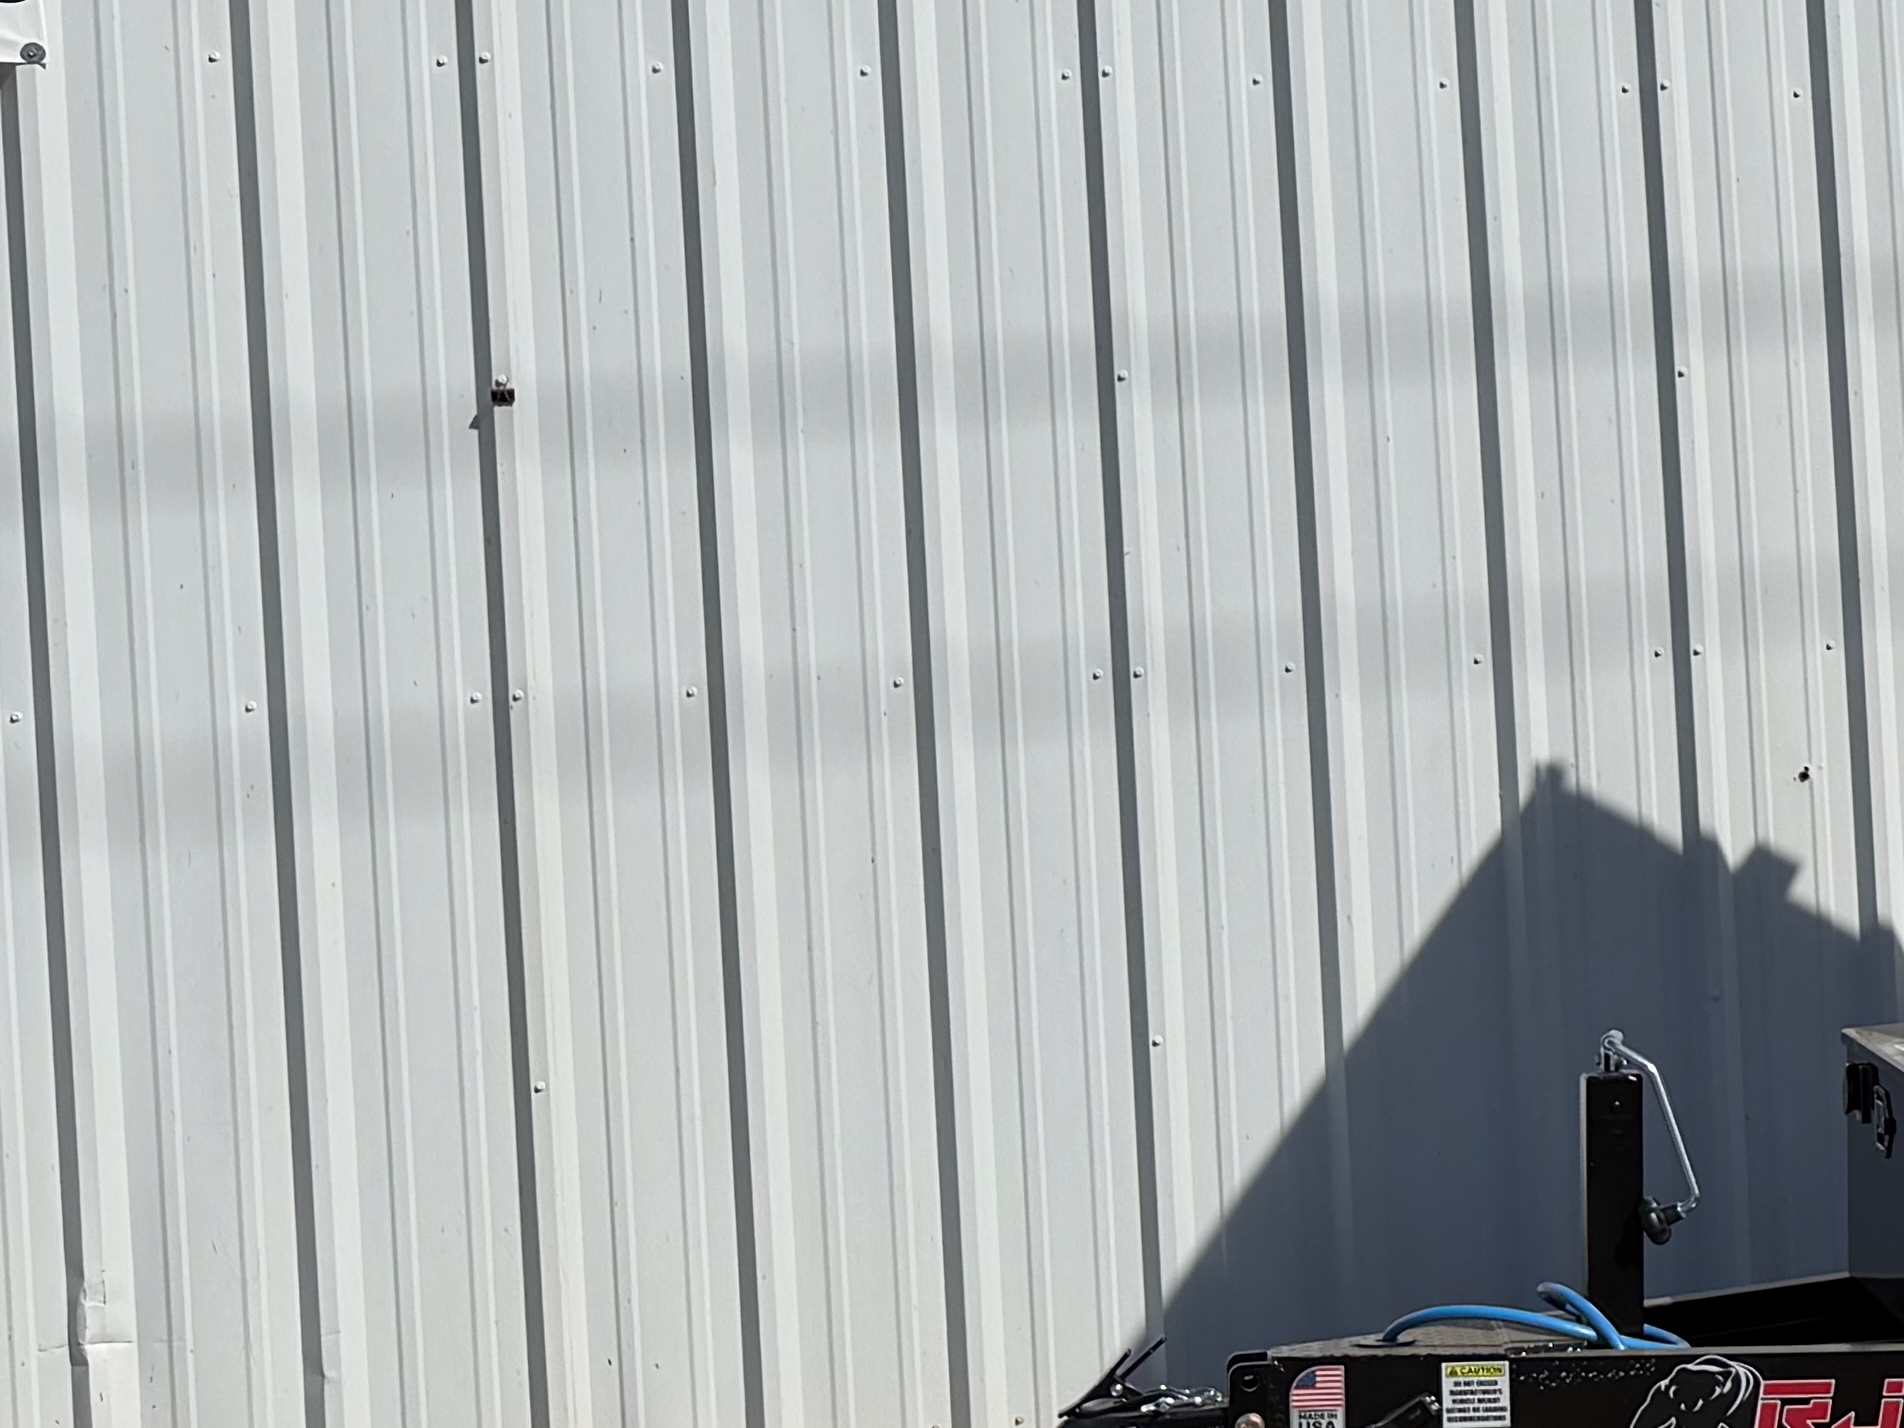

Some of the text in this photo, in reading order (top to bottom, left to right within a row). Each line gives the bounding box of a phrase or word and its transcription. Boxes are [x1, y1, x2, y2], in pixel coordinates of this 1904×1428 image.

[1460, 1366, 1503, 1376] CAUTION
[1298, 1412, 1338, 1420] MADE IN
